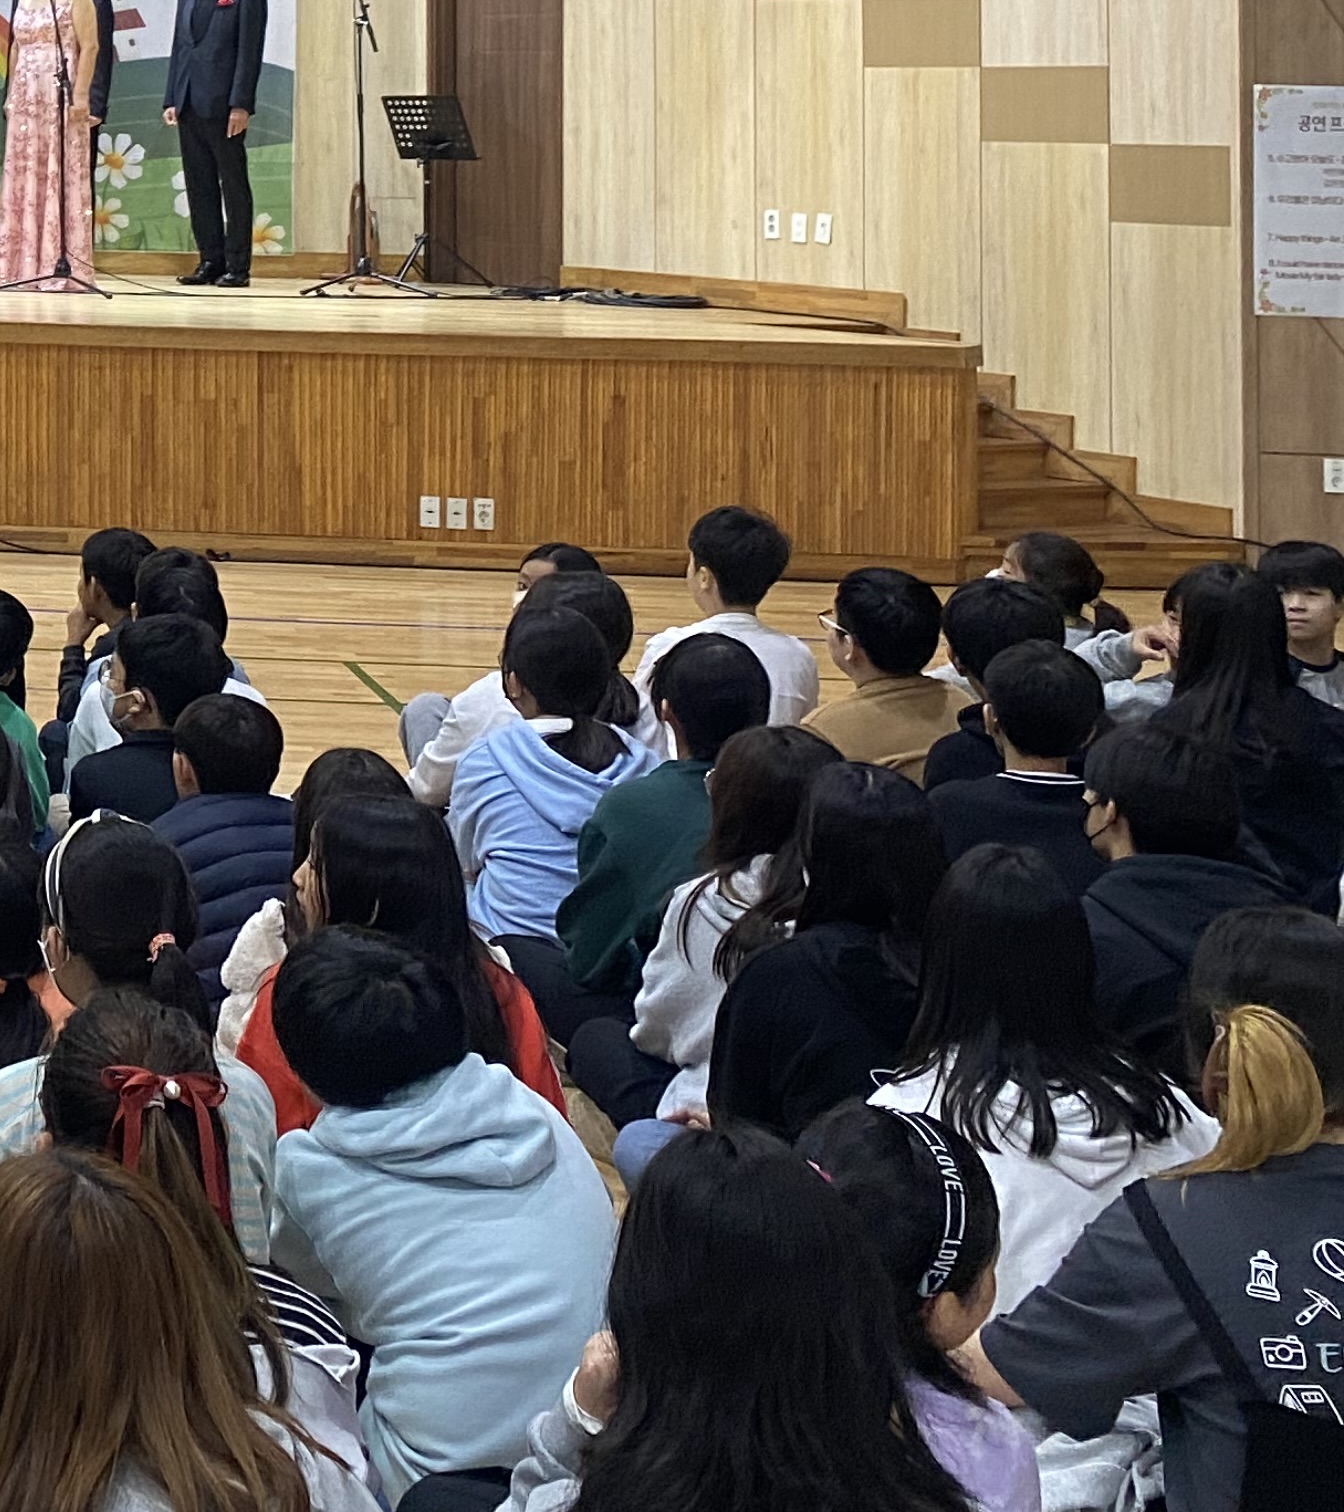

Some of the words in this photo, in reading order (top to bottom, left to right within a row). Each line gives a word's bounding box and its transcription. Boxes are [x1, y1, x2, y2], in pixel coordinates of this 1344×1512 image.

[1298, 114, 1327, 133] 공연
[928, 1144, 964, 1195] LOVE
[926, 1238, 963, 1281] LOVE
